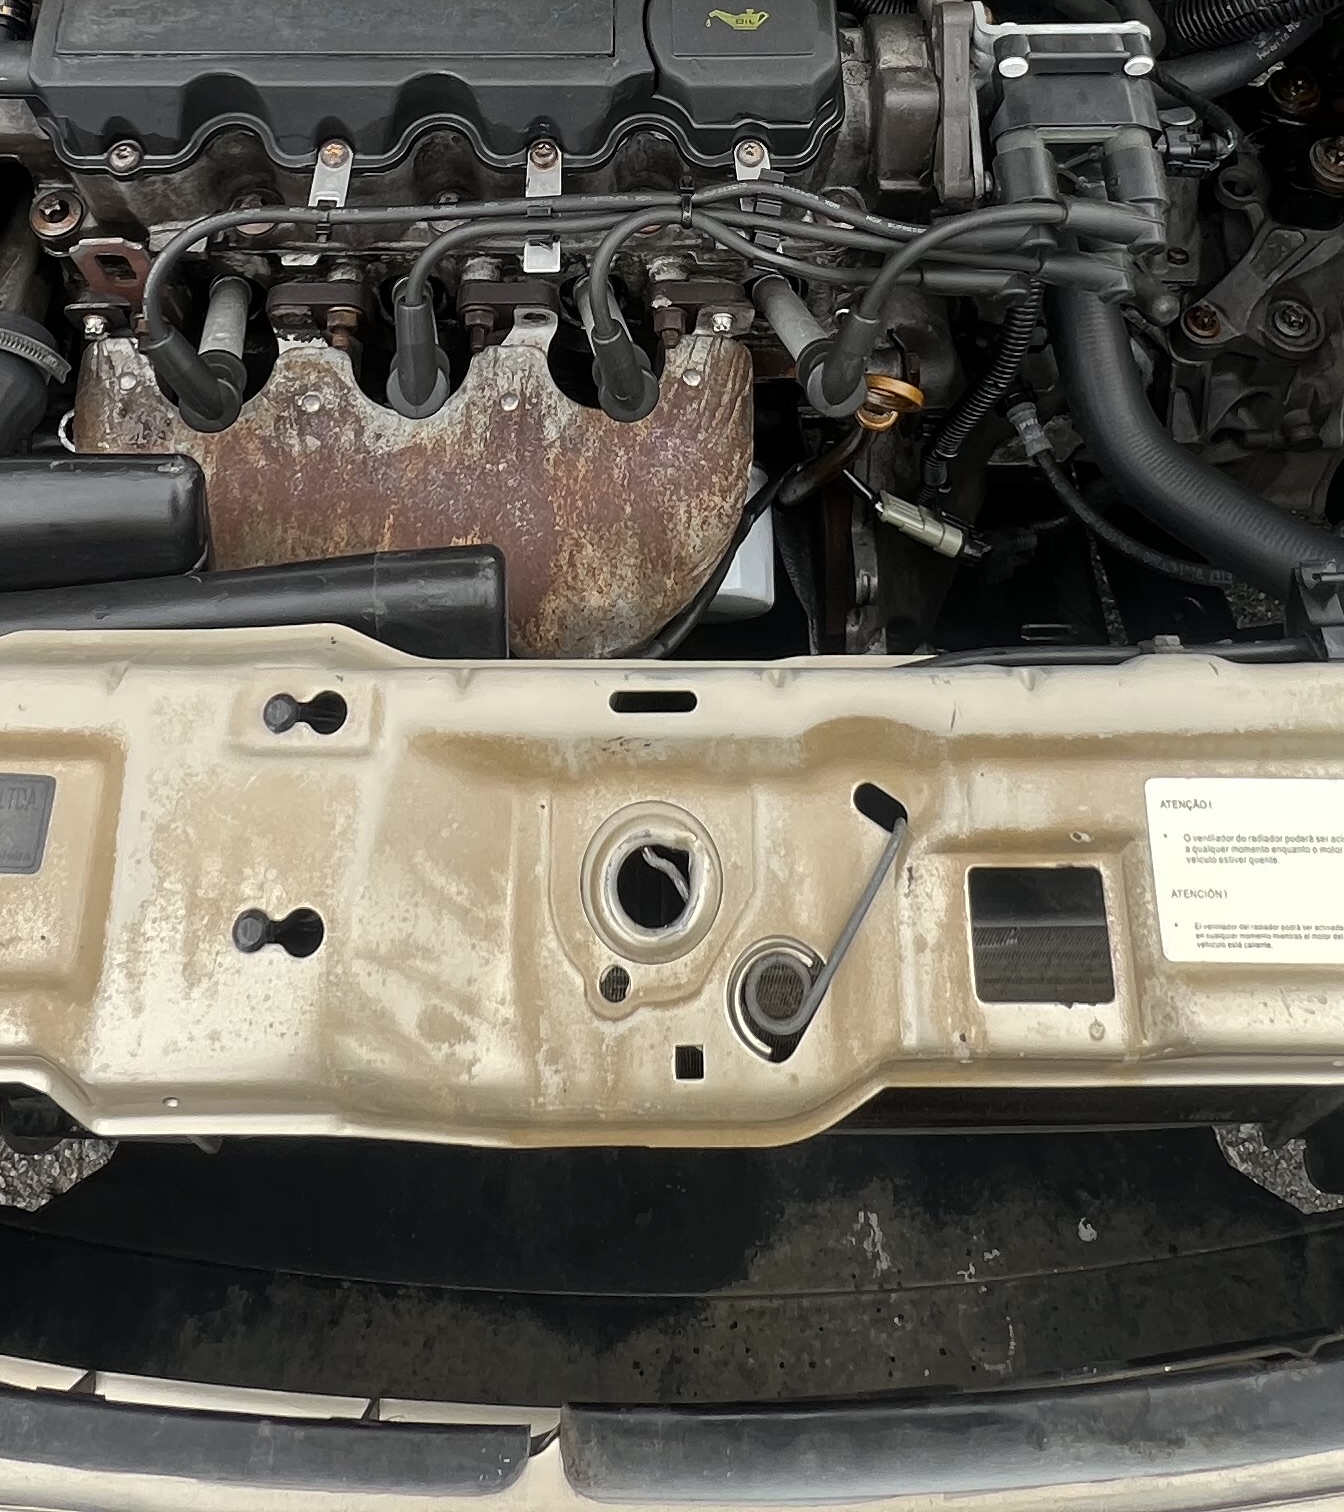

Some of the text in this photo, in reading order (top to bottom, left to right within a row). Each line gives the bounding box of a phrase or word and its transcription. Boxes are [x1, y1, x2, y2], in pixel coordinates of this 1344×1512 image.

[736, 18, 755, 26] OIL
[1183, 833, 1192, 843] O
[1192, 834, 1235, 843] ventilador
[1236, 834, 1247, 843] do
[1248, 834, 1283, 843] radiador
[1192, 845, 1229, 856] qualquer
[1231, 845, 1270, 853] momento
